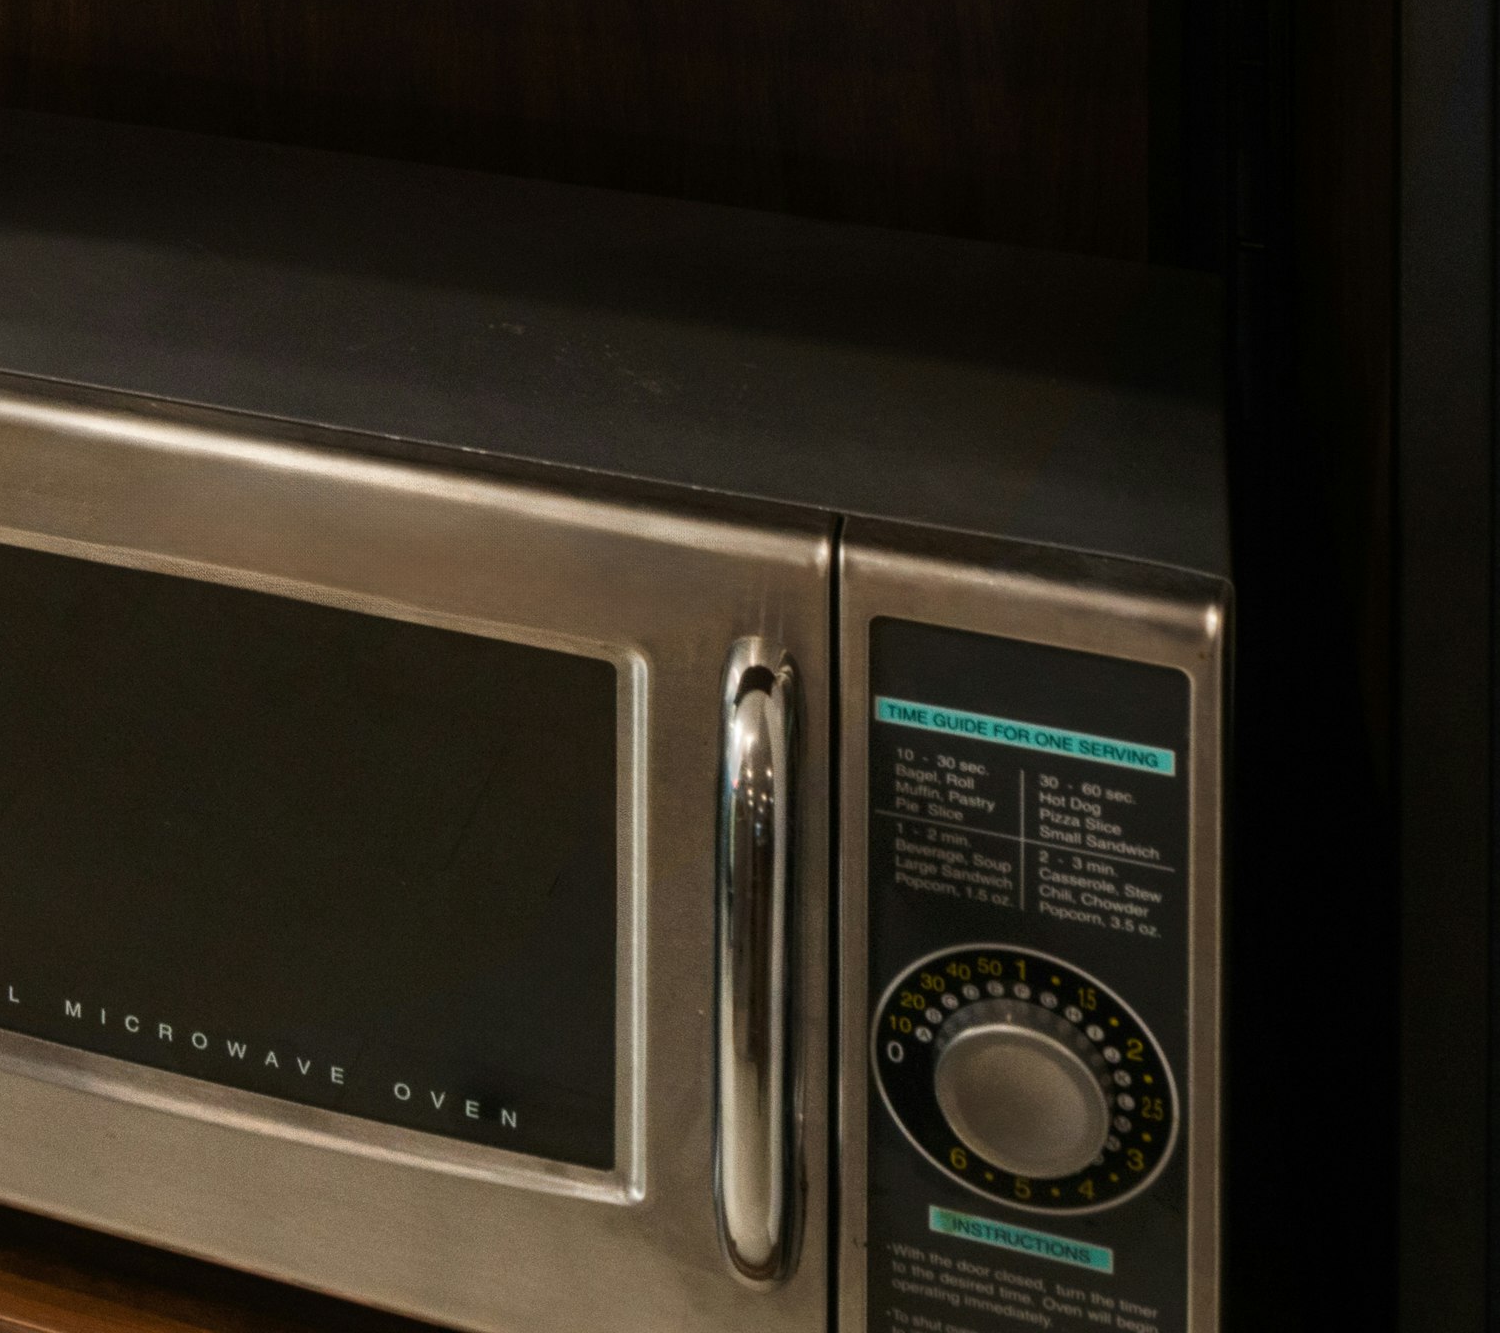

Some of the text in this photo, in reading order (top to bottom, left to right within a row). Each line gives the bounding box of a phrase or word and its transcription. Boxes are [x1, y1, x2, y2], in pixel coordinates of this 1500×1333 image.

[888, 704, 1159, 768] TIME GUIDE FOR ONE SERVING
[64, 998, 345, 1086] MICROWAVE
[392, 1081, 519, 1128] OVEN
[952, 1217, 1091, 1264] INSTRUCTIONS
